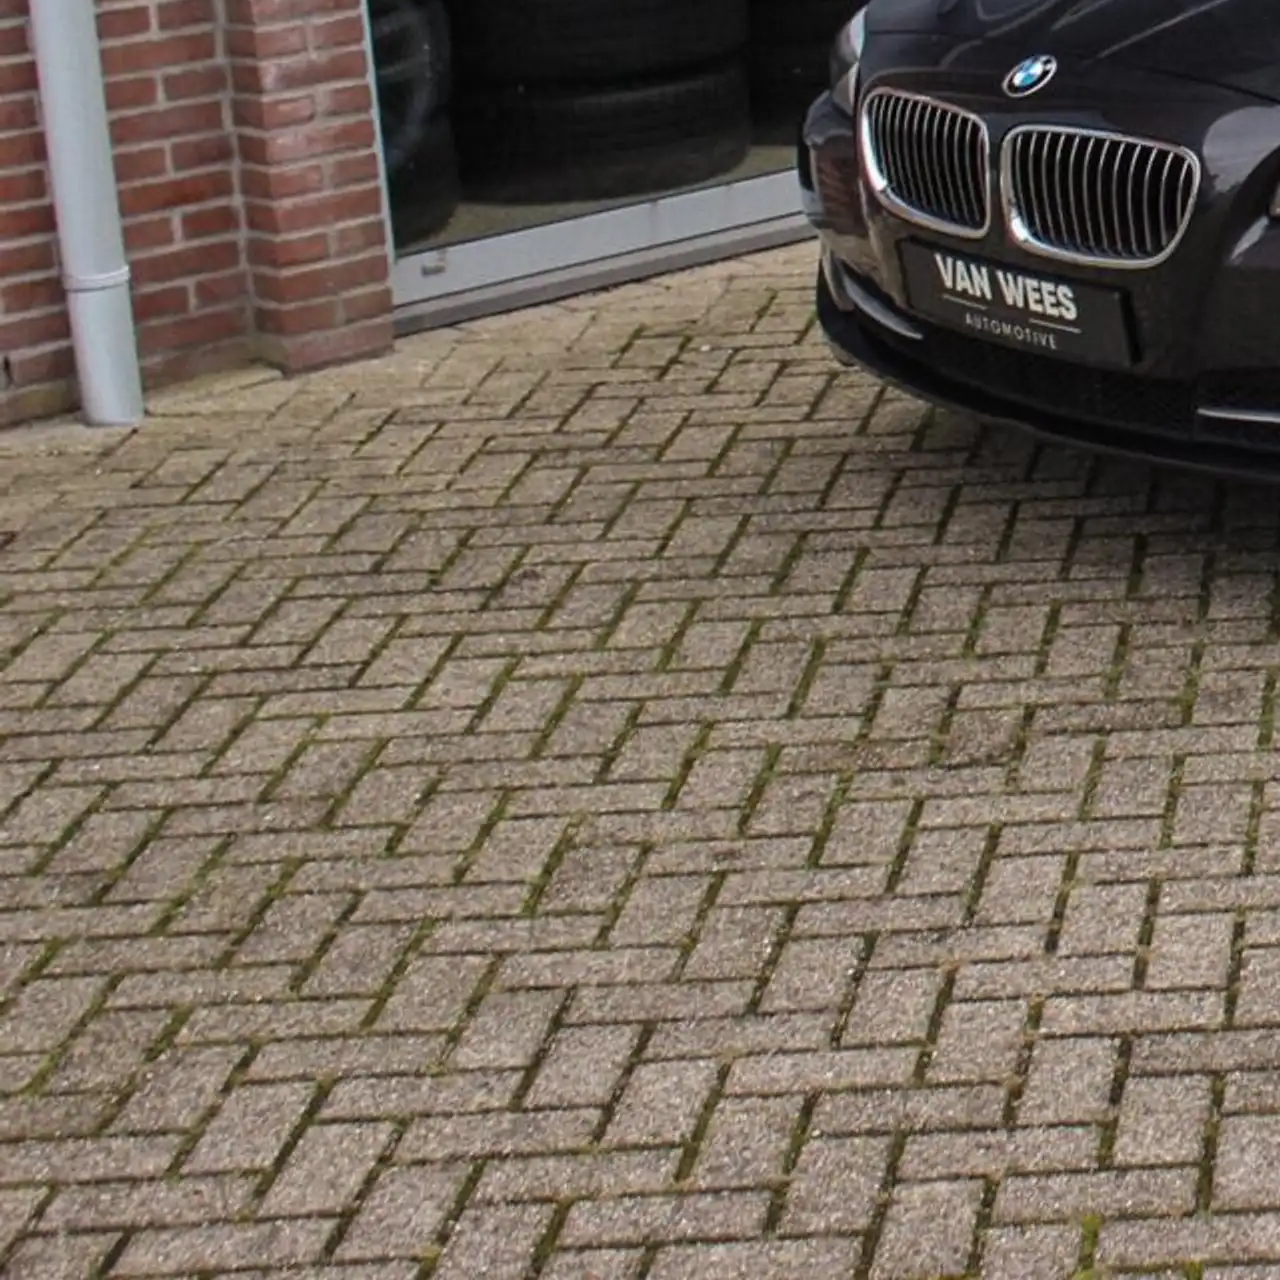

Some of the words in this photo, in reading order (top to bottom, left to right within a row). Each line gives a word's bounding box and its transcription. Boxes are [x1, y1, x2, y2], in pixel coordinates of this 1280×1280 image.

[934, 252, 992, 301] VAN
[996, 270, 1077, 321] WEES
[965, 313, 1057, 349] AUTOMOTIVE
